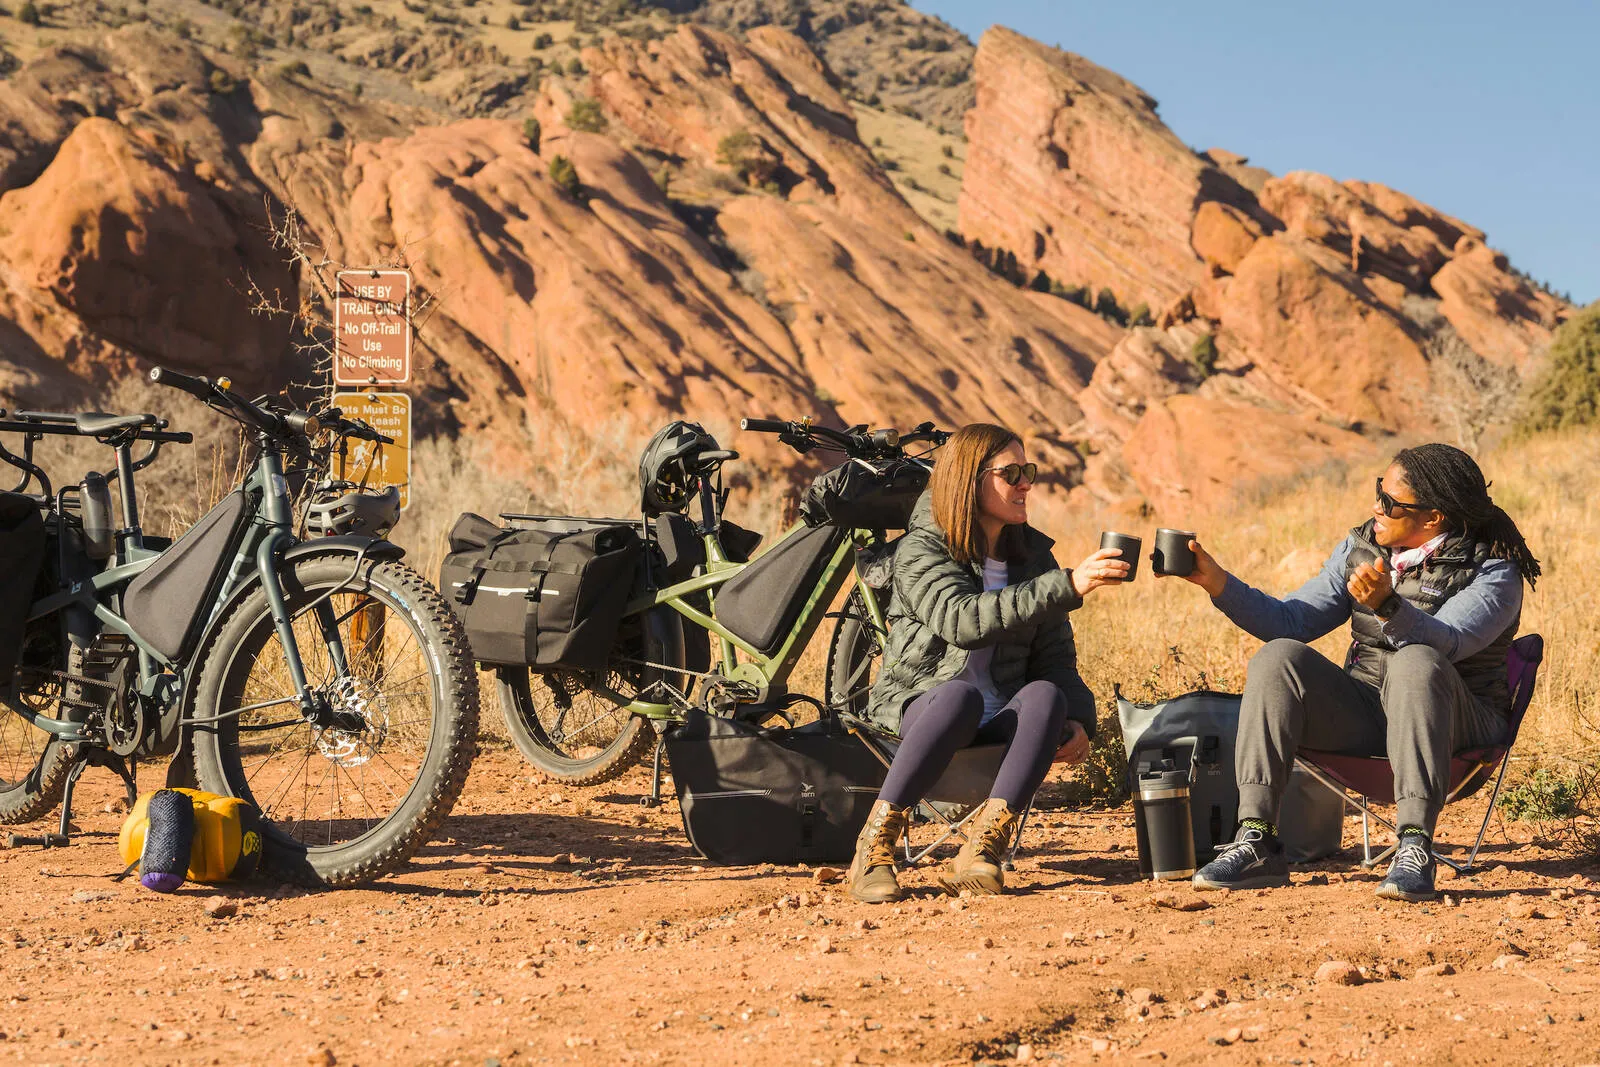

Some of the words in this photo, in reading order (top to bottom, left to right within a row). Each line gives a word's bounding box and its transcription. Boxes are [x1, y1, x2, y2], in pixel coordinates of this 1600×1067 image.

[353, 286, 375, 298] USE
[377, 286, 392, 298] BY
[343, 303, 373, 315] TRAIL
[375, 303, 404, 315] ONLY
[345, 322, 359, 335] No
[361, 322, 401, 335] Off-Trail
[362, 339, 382, 351] Use
[342, 356, 356, 368] No
[358, 356, 402, 372] Climbing
[362, 404, 388, 414] Must
[392, 404, 407, 414] Be
[369, 416, 401, 425] Leash
